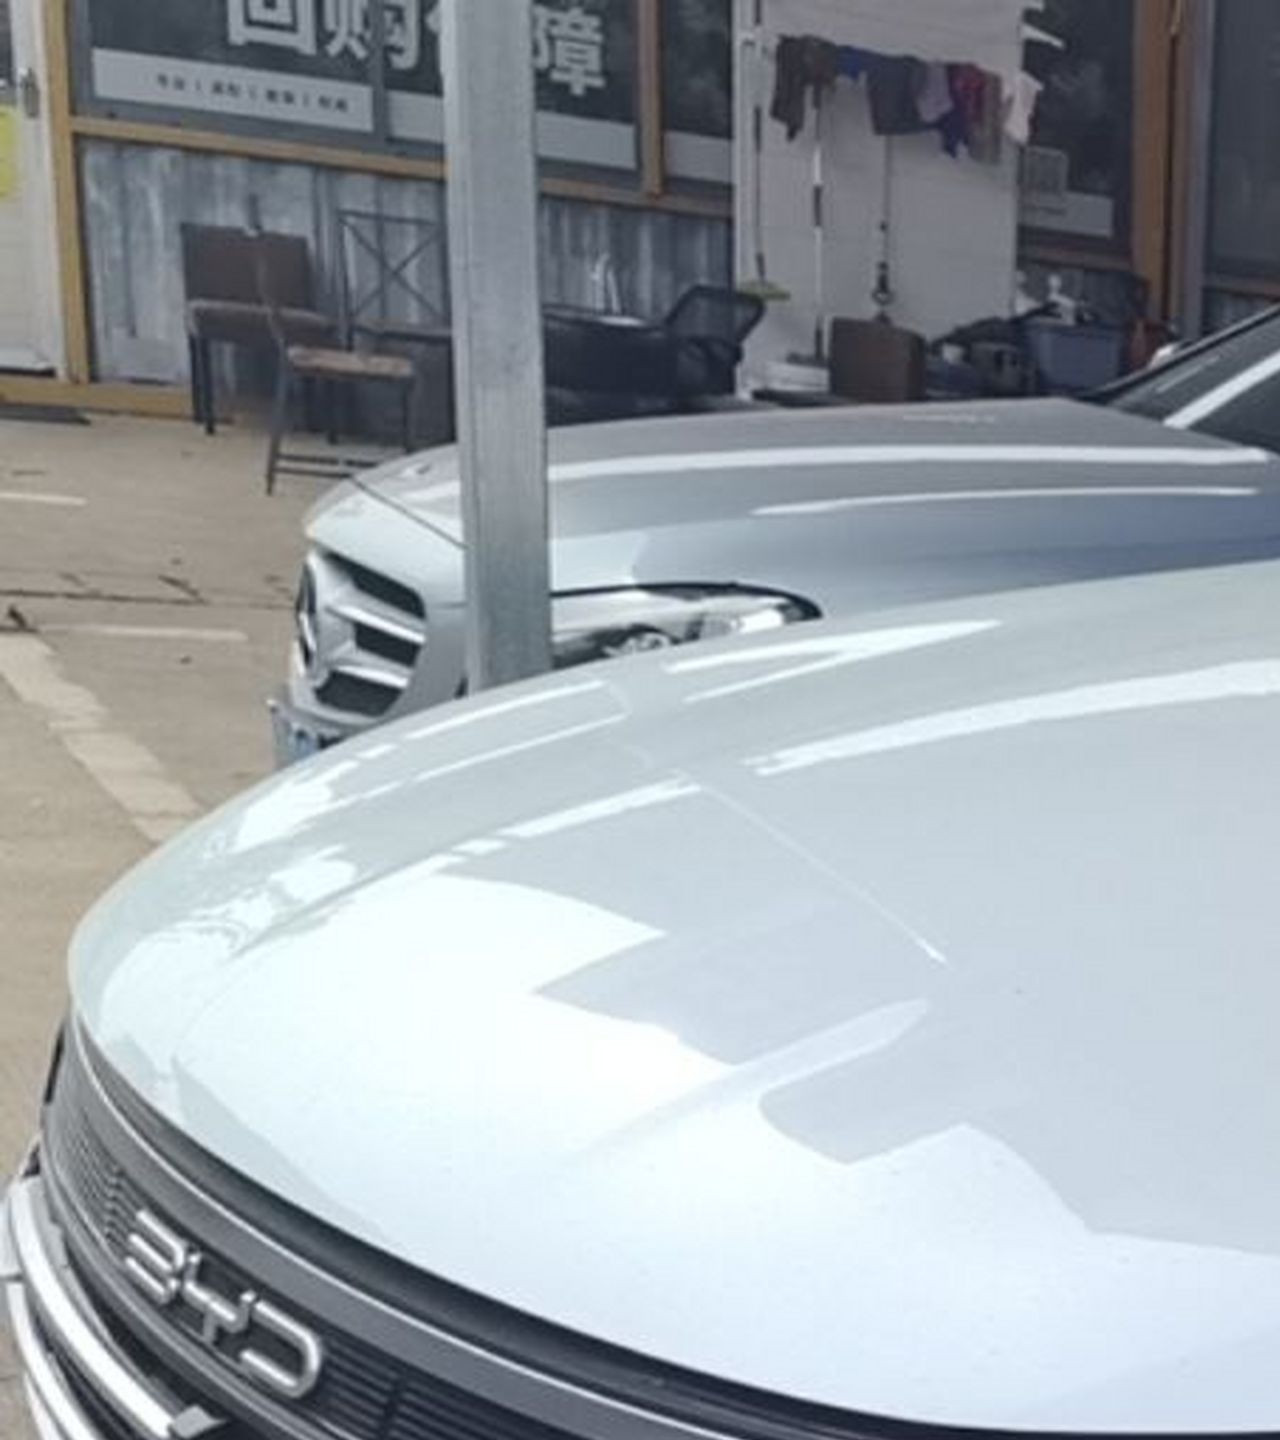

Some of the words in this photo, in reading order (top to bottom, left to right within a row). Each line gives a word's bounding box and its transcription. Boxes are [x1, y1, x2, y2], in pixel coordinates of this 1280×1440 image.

[227, 0, 607, 95] 回购障
[125, 1209, 323, 1399] BYD
